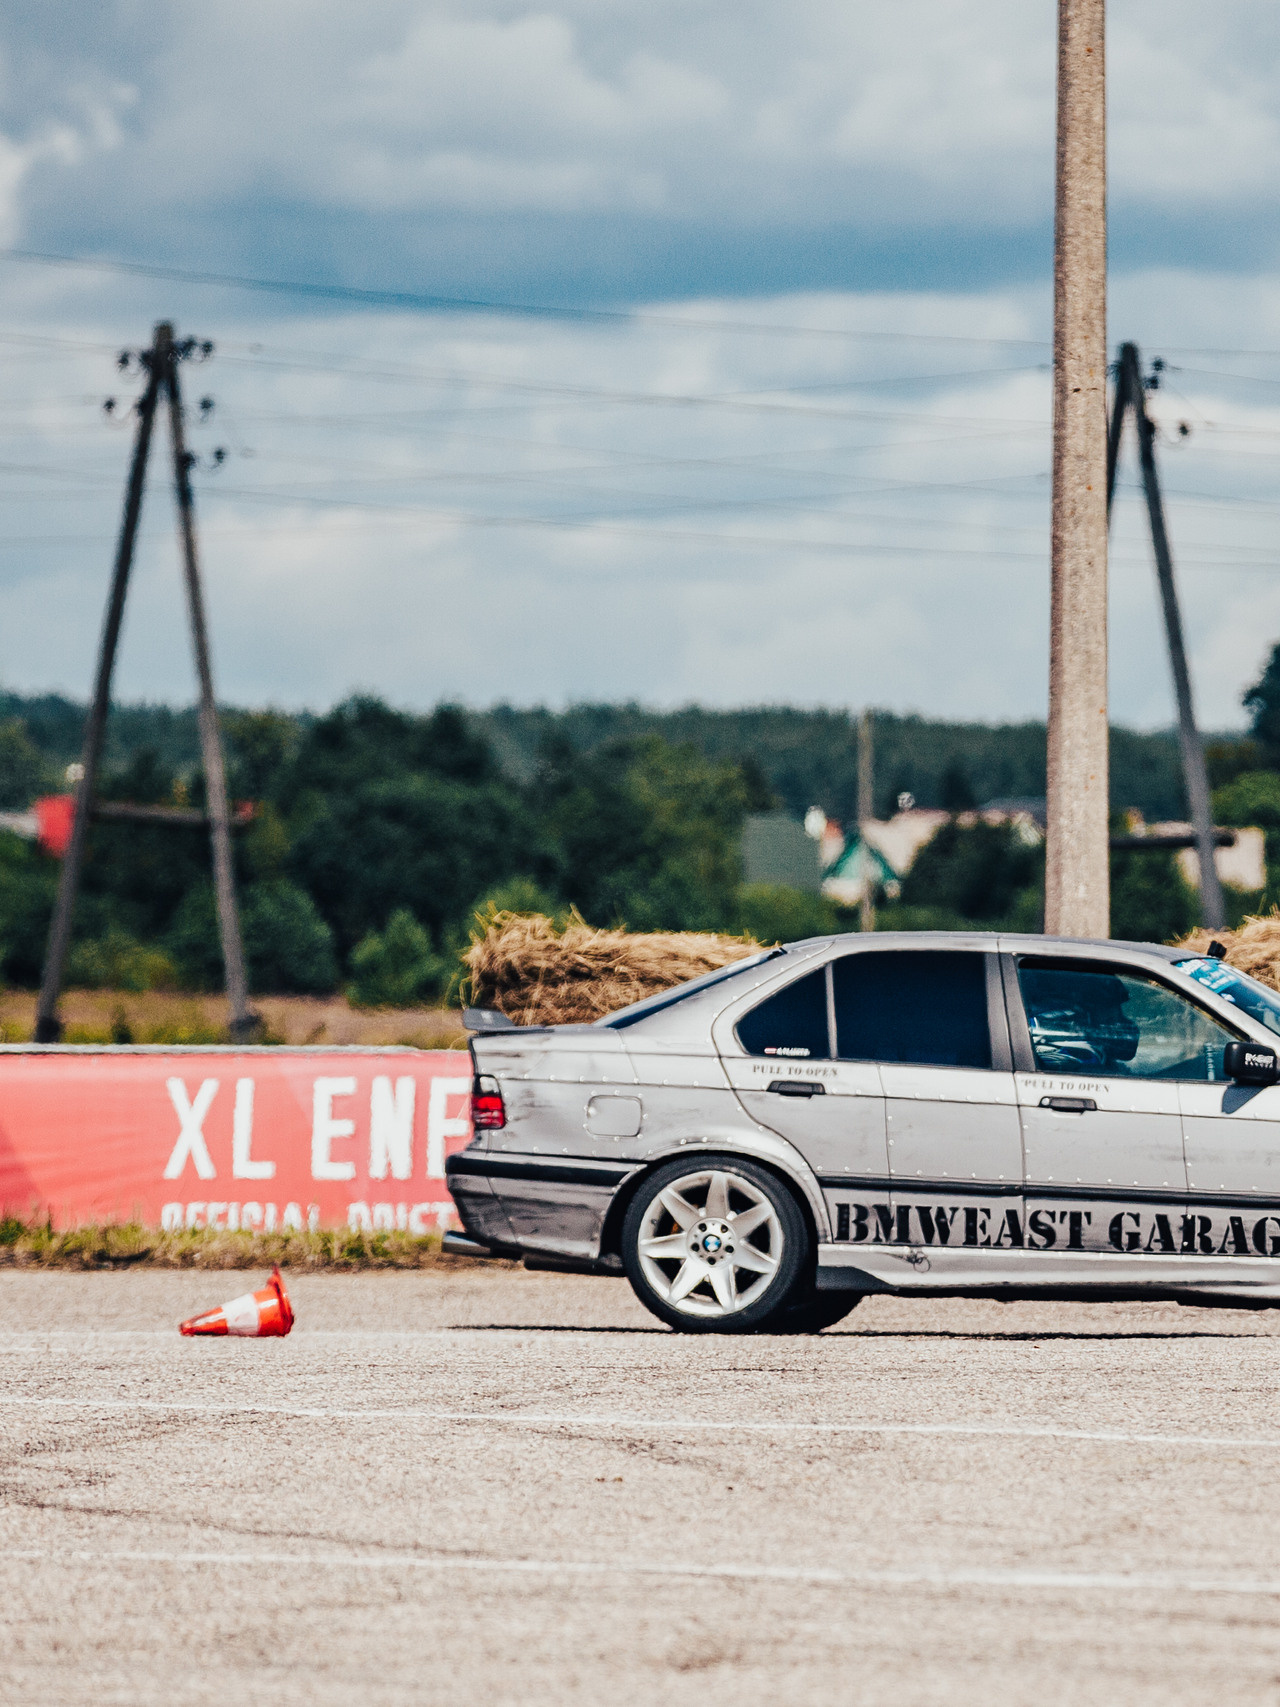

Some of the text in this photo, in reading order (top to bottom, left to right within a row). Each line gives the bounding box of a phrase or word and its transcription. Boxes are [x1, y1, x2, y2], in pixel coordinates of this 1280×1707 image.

[753, 1064, 838, 1077] PULL TO OPEN
[1022, 1078, 1110, 1093] PULL TO OPEN
[163, 1076, 276, 1181] XL
[833, 1202, 1092, 1249] BMWEAST
